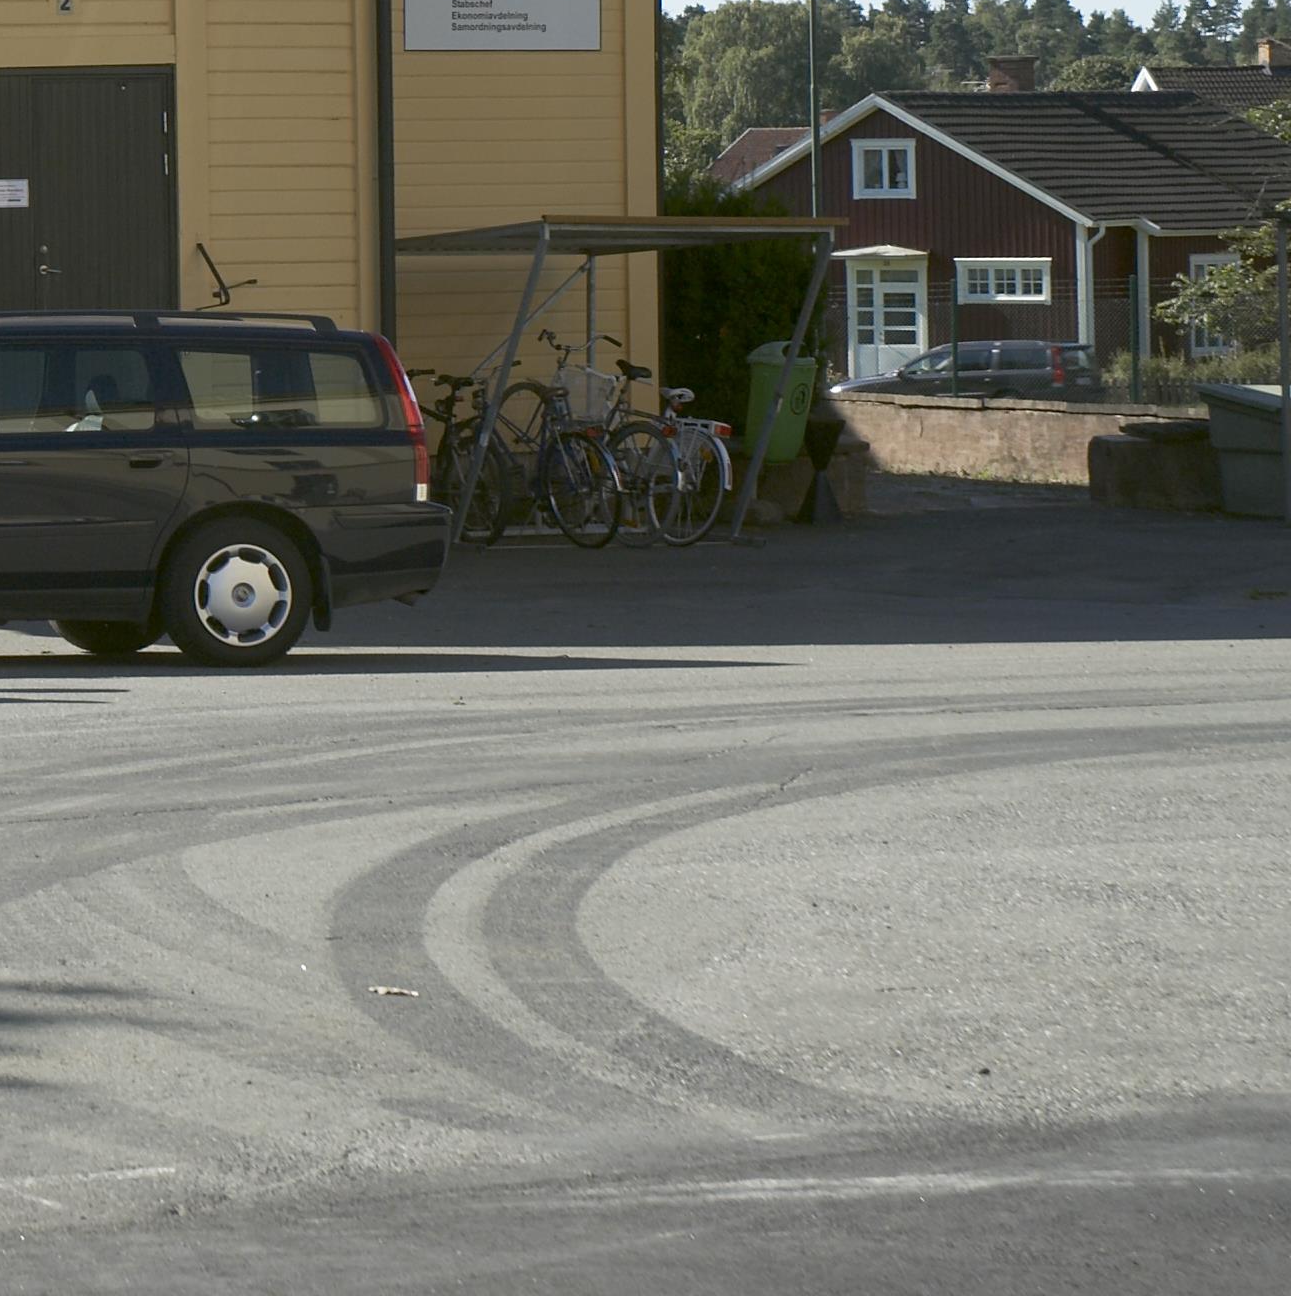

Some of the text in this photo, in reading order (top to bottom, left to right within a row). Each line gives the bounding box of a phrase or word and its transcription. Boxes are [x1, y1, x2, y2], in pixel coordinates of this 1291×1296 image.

[451, 0, 493, 8] Stabschef
[451, 11, 528, 21] Ekonomiavdelning
[451, 22, 547, 32] Samordningsavdelning
